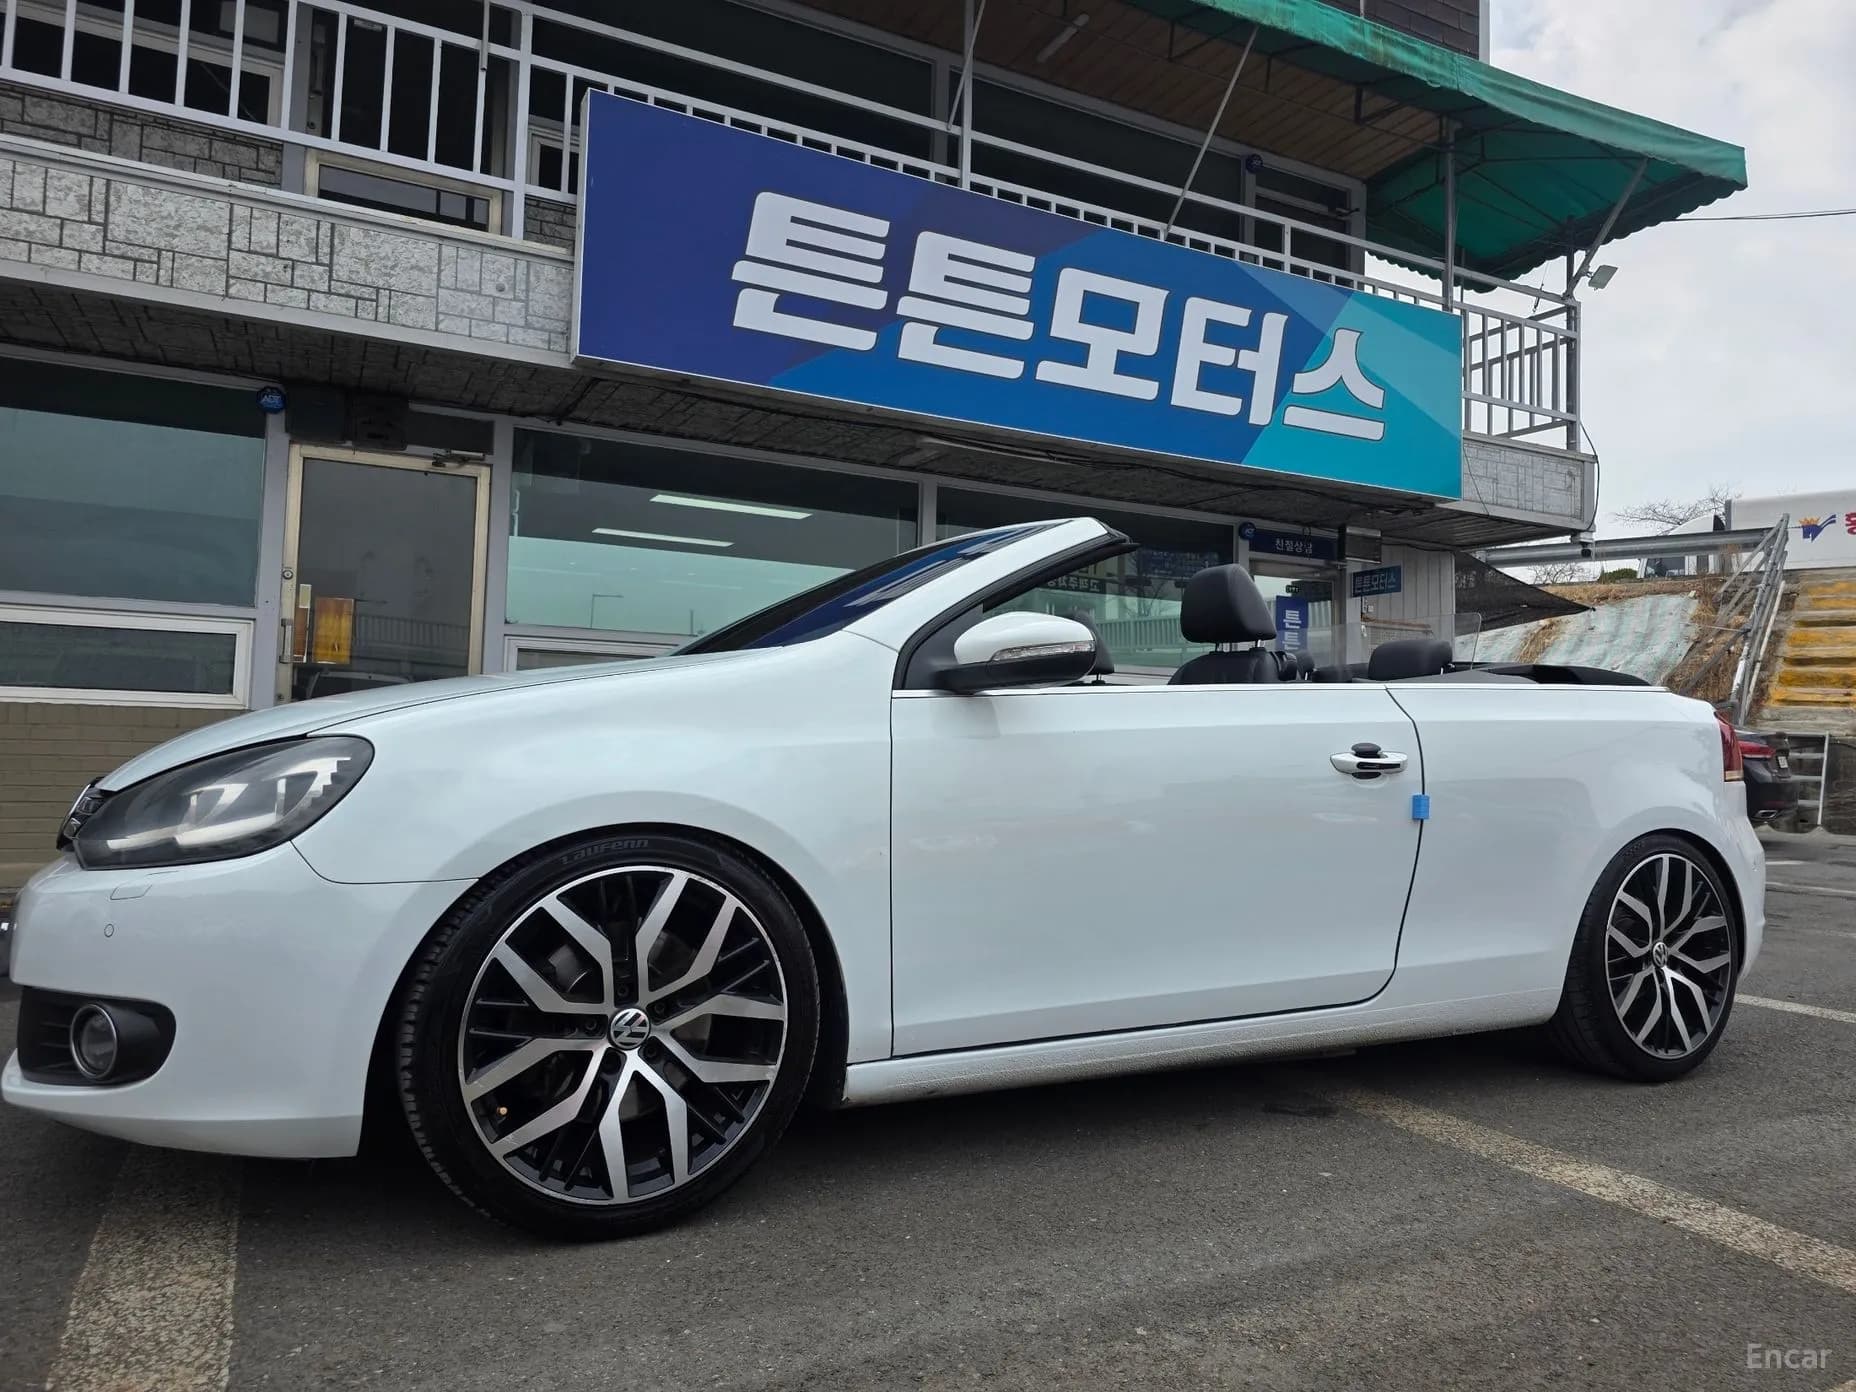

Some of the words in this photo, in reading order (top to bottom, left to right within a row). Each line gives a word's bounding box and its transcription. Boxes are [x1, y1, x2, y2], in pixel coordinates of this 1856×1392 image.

[731, 190, 1386, 442] 튼튼모터스
[1354, 571, 1397, 593] 튼튼모터스
[1282, 609, 1302, 650] 튼튼
